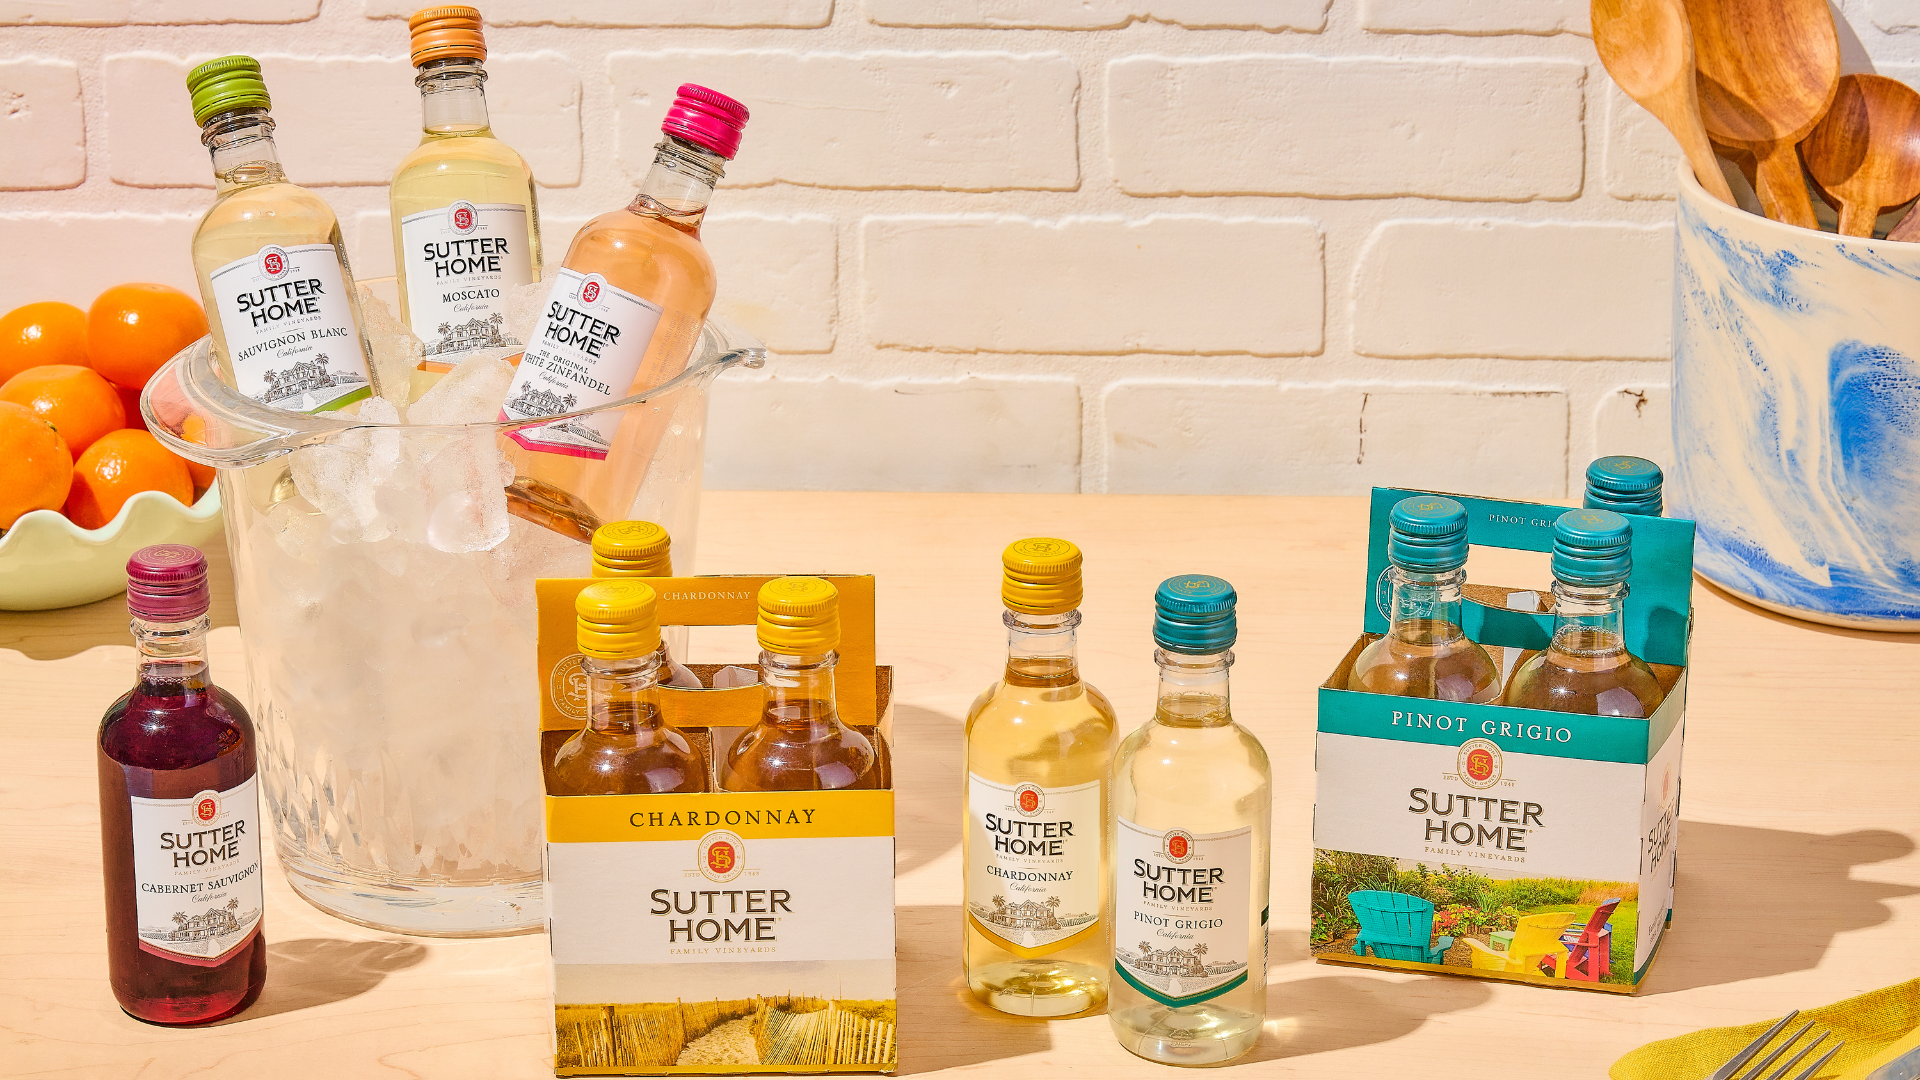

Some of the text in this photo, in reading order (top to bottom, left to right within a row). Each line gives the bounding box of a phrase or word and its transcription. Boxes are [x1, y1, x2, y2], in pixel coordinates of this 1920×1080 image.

[423, 237, 510, 262] SUTTER
[463, 274, 502, 283] VINEYARDS
[236, 278, 327, 313] SUTTER
[442, 288, 500, 303] MOSCATO
[453, 303, 489, 313] California
[547, 300, 622, 346] SUTTER
[238, 327, 348, 362] SAUVIGNON BLANC
[276, 345, 314, 359] California
[539, 349, 589, 375] THE ORIGINAL
[524, 352, 611, 396] WHITE ZINFANDEL
[538, 371, 569, 390] California
[1489, 513, 1527, 525] PINOT
[663, 591, 751, 602] CHARDONNAY
[1391, 710, 1574, 744] PINOT GRIGIO
[629, 807, 816, 828] CHARDONNAY
[1408, 787, 1546, 828] SUTTER
[160, 819, 247, 850] SUTTER
[985, 812, 1075, 838] SUTTER
[1424, 846, 1526, 864] FAMILY VINEYARDS
[141, 859, 259, 894] CABERNET SAUVIGNON
[986, 865, 1074, 882] CHARDONNAY
[1133, 858, 1225, 886] SUTTER
[191, 891, 227, 904] California
[1009, 882, 1047, 893] California
[650, 888, 795, 916] SUTTER
[1143, 900, 1168, 910] FAMILY
[1133, 910, 1223, 930] PINOT GRIGIO
[1156, 928, 1195, 940] California
[715, 946, 777, 954] VINEYARDS
